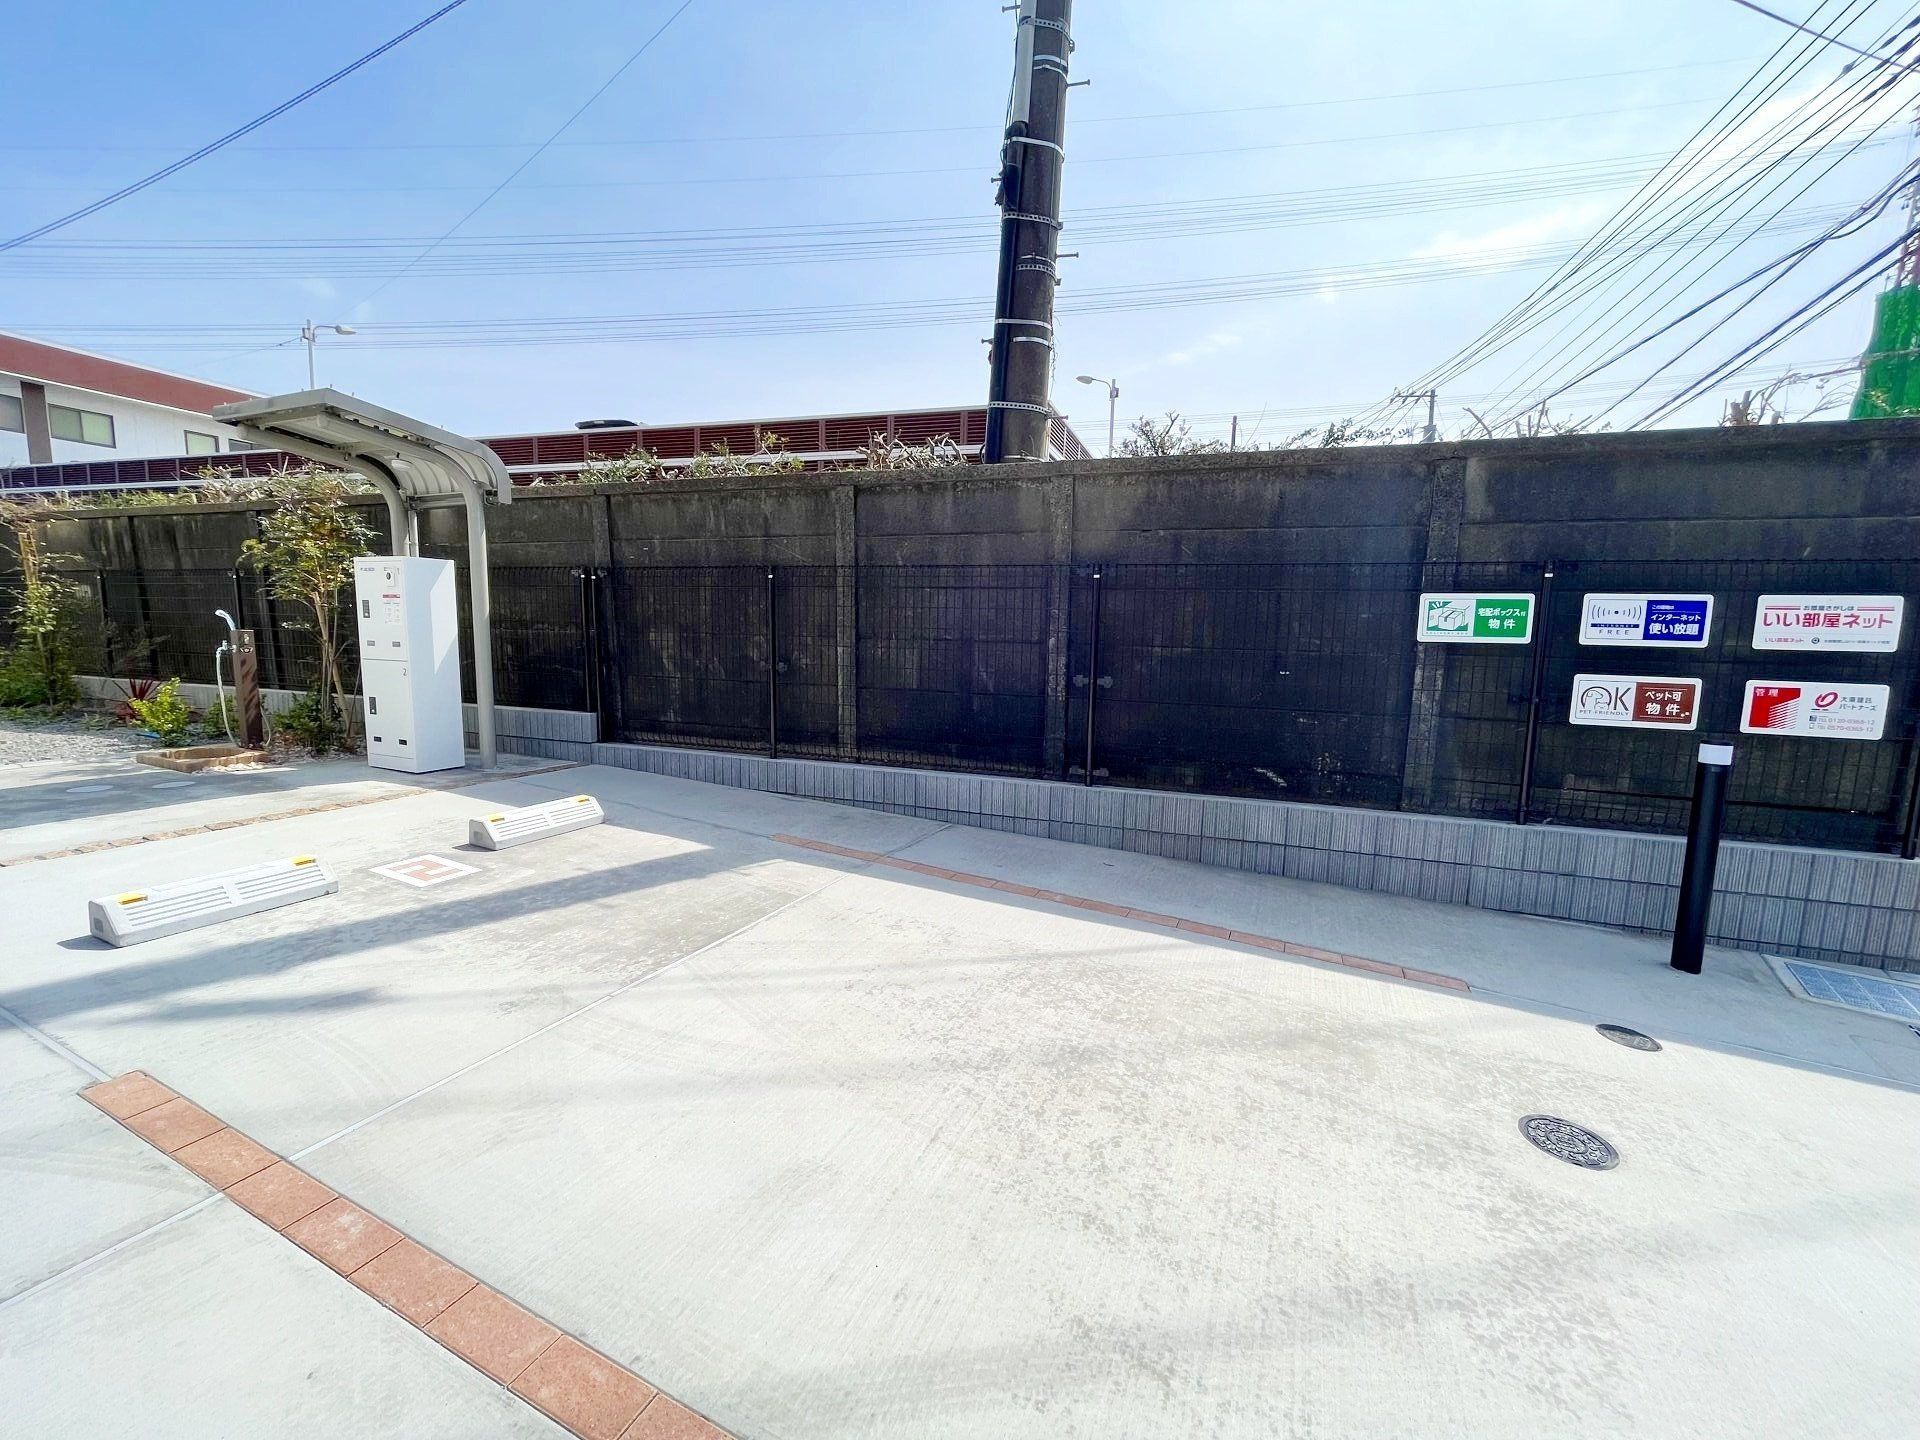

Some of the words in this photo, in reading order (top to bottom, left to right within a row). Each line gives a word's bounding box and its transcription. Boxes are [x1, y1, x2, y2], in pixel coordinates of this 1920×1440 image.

[1650, 613, 1702, 622] インターネット
[1763, 612, 1893, 629] いい部屋ネット
[1487, 618, 1516, 630] 物件
[1648, 623, 1700, 636] 使い放題
[1645, 691, 1682, 702] ペット可
[1755, 688, 1779, 697] 管理
[1645, 702, 1680, 716] 物件
